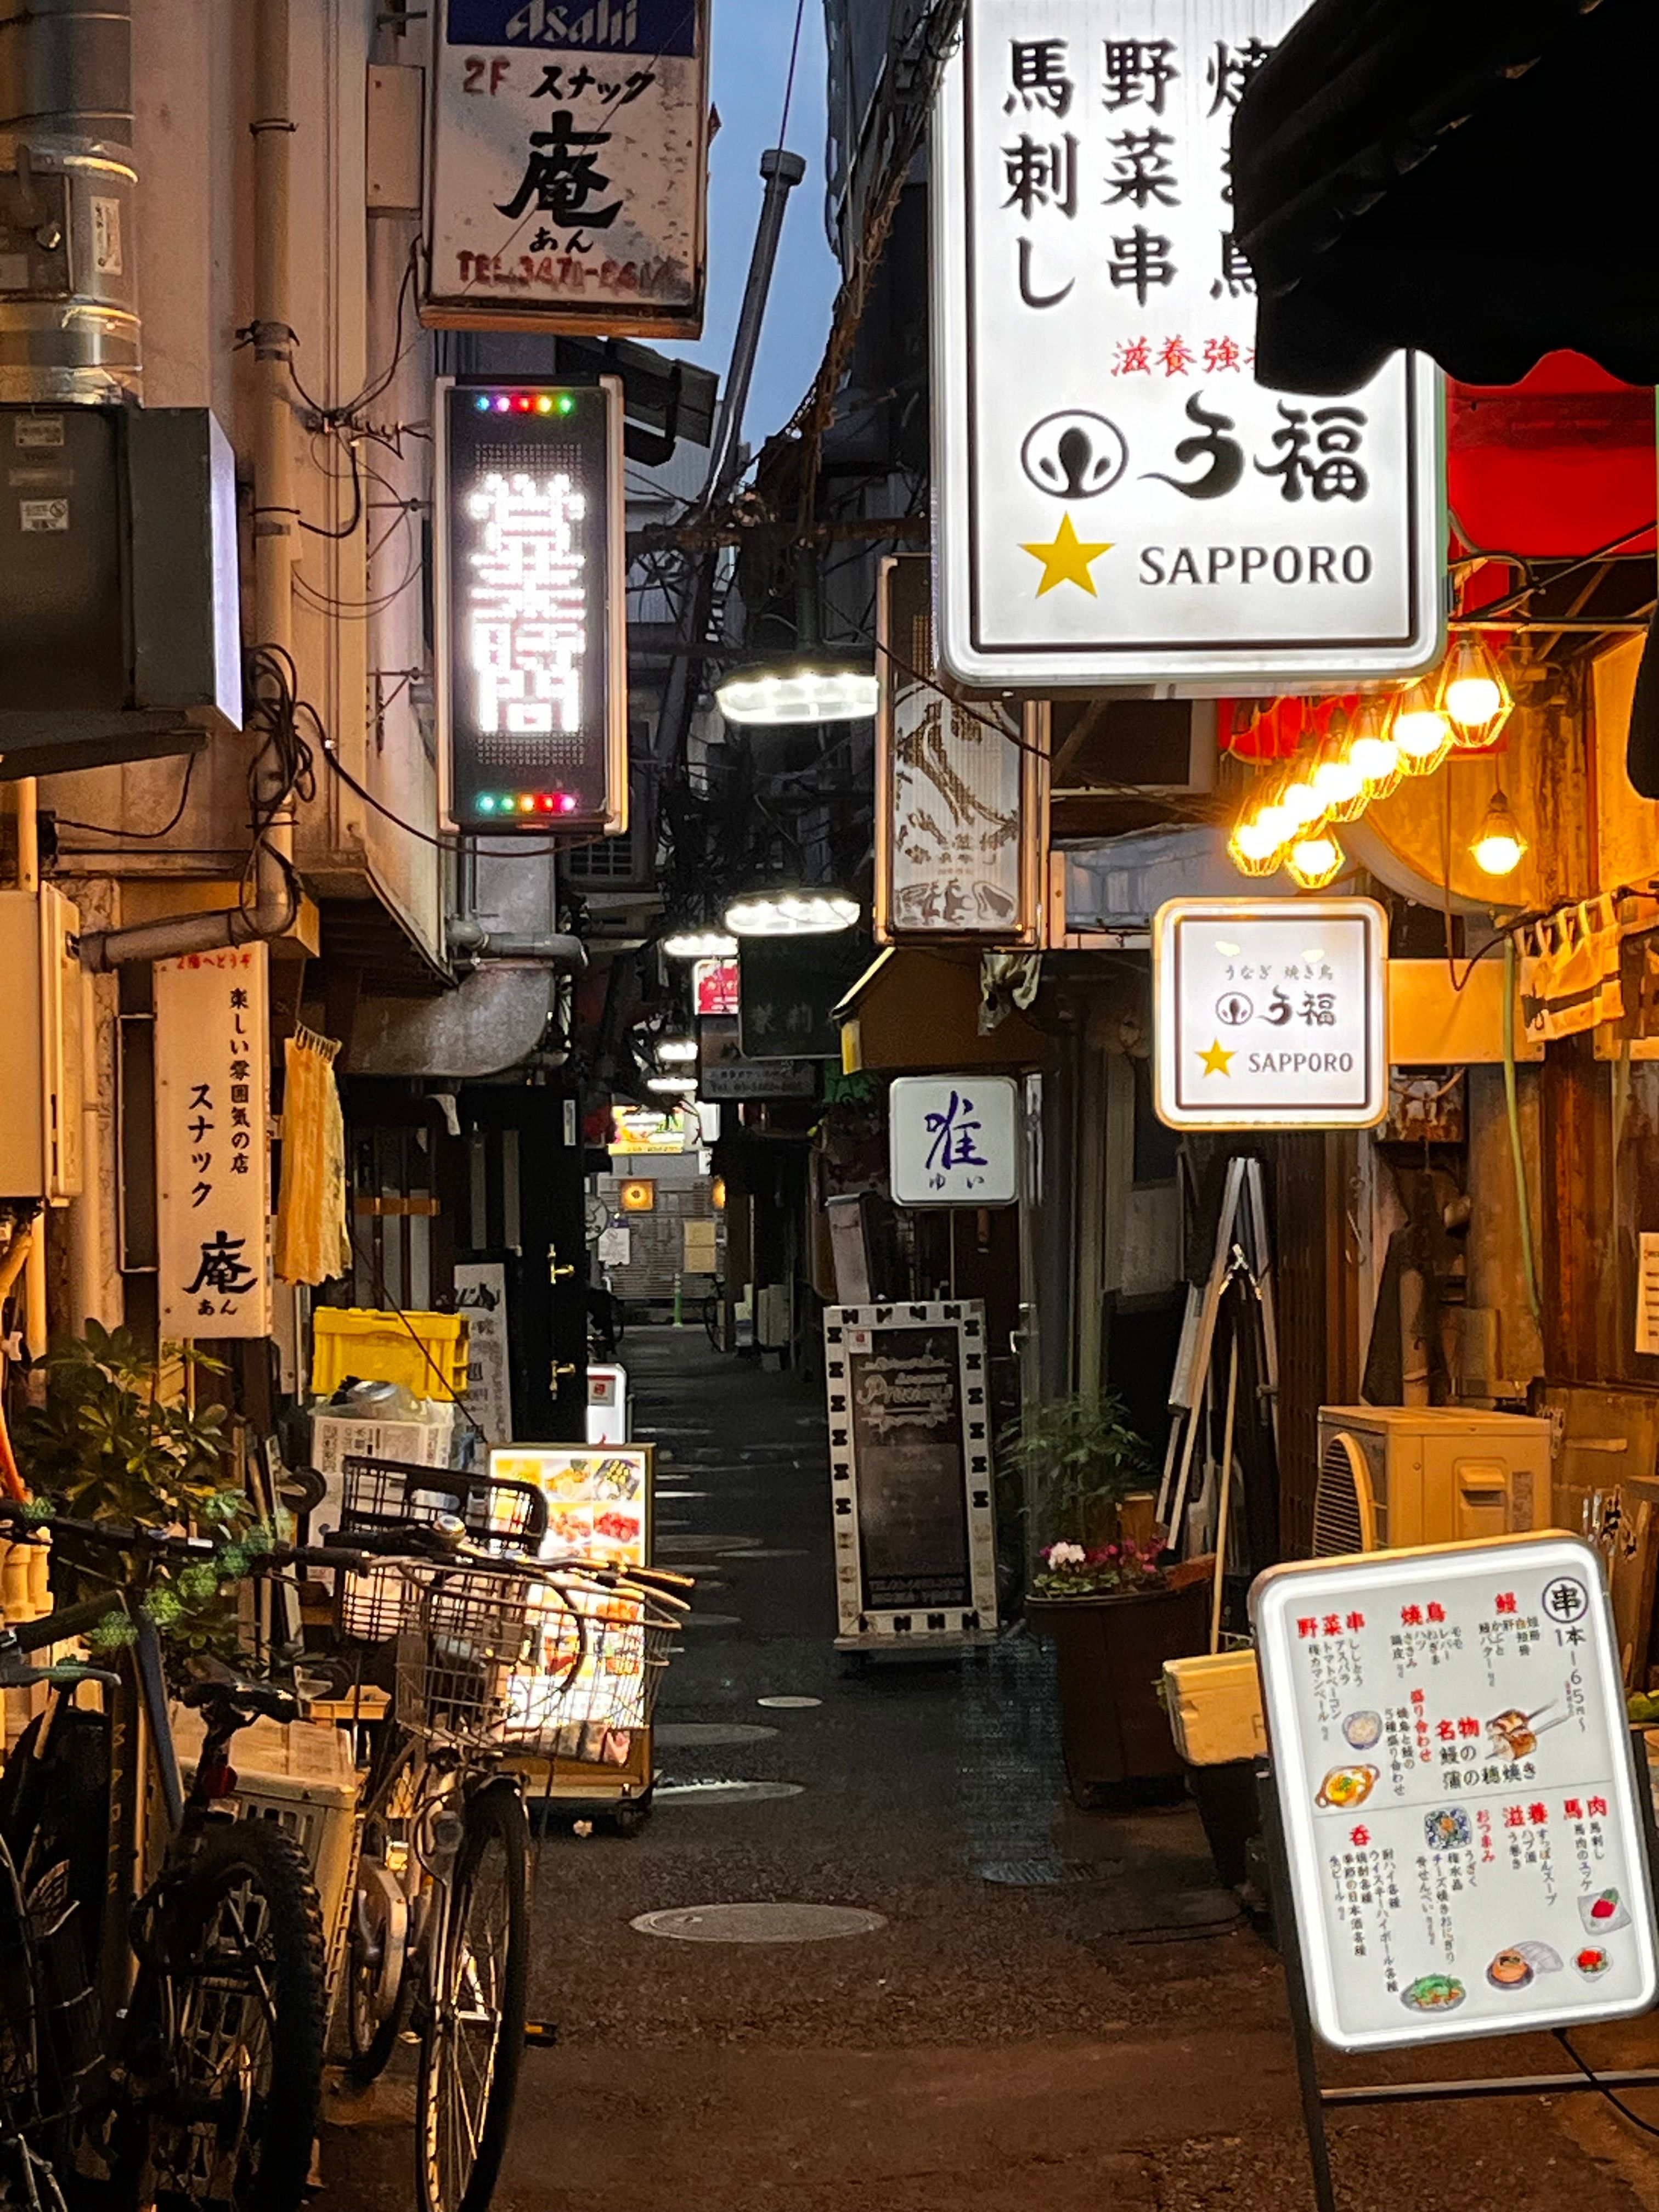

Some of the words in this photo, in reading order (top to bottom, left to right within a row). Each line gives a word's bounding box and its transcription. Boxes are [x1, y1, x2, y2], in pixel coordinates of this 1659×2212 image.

[506, 0, 638, 47] Asahi
[463, 55, 510, 95] 2F
[529, 65, 656, 105] スナック
[493, 110, 624, 229] 庵
[1000, 37, 1080, 311] 馬刺し
[1101, 37, 1181, 307] 野菜串
[529, 227, 594, 253] あん
[1110, 335, 1255, 378] 滋養強
[1137, 390, 1370, 503] う福
[1139, 545, 1373, 585] SAPPORO
[1226, 965, 1272, 980] うなぎ
[1284, 964, 1334, 980] 焼き鳥
[1259, 985, 1336, 1026] う福
[1249, 1052, 1353, 1073] SAPPORO
[230, 988, 250, 1175] 楽しい雰囲気の店
[183, 1230, 258, 1294] 庵
[198, 1298, 238, 1317] あん
[1400, 1601, 1447, 1627] 焼鳥
[1551, 1584, 1581, 1619] 串
[1296, 1611, 1365, 1640] 野菜串
[1555, 1626, 1586, 1647] 1本
[1436, 1717, 1480, 1741] 名物
[1440, 1745, 1477, 1765] 鰻の
[1503, 1802, 1548, 1829] 滋養
[1564, 1795, 1609, 1821] 馬肉
